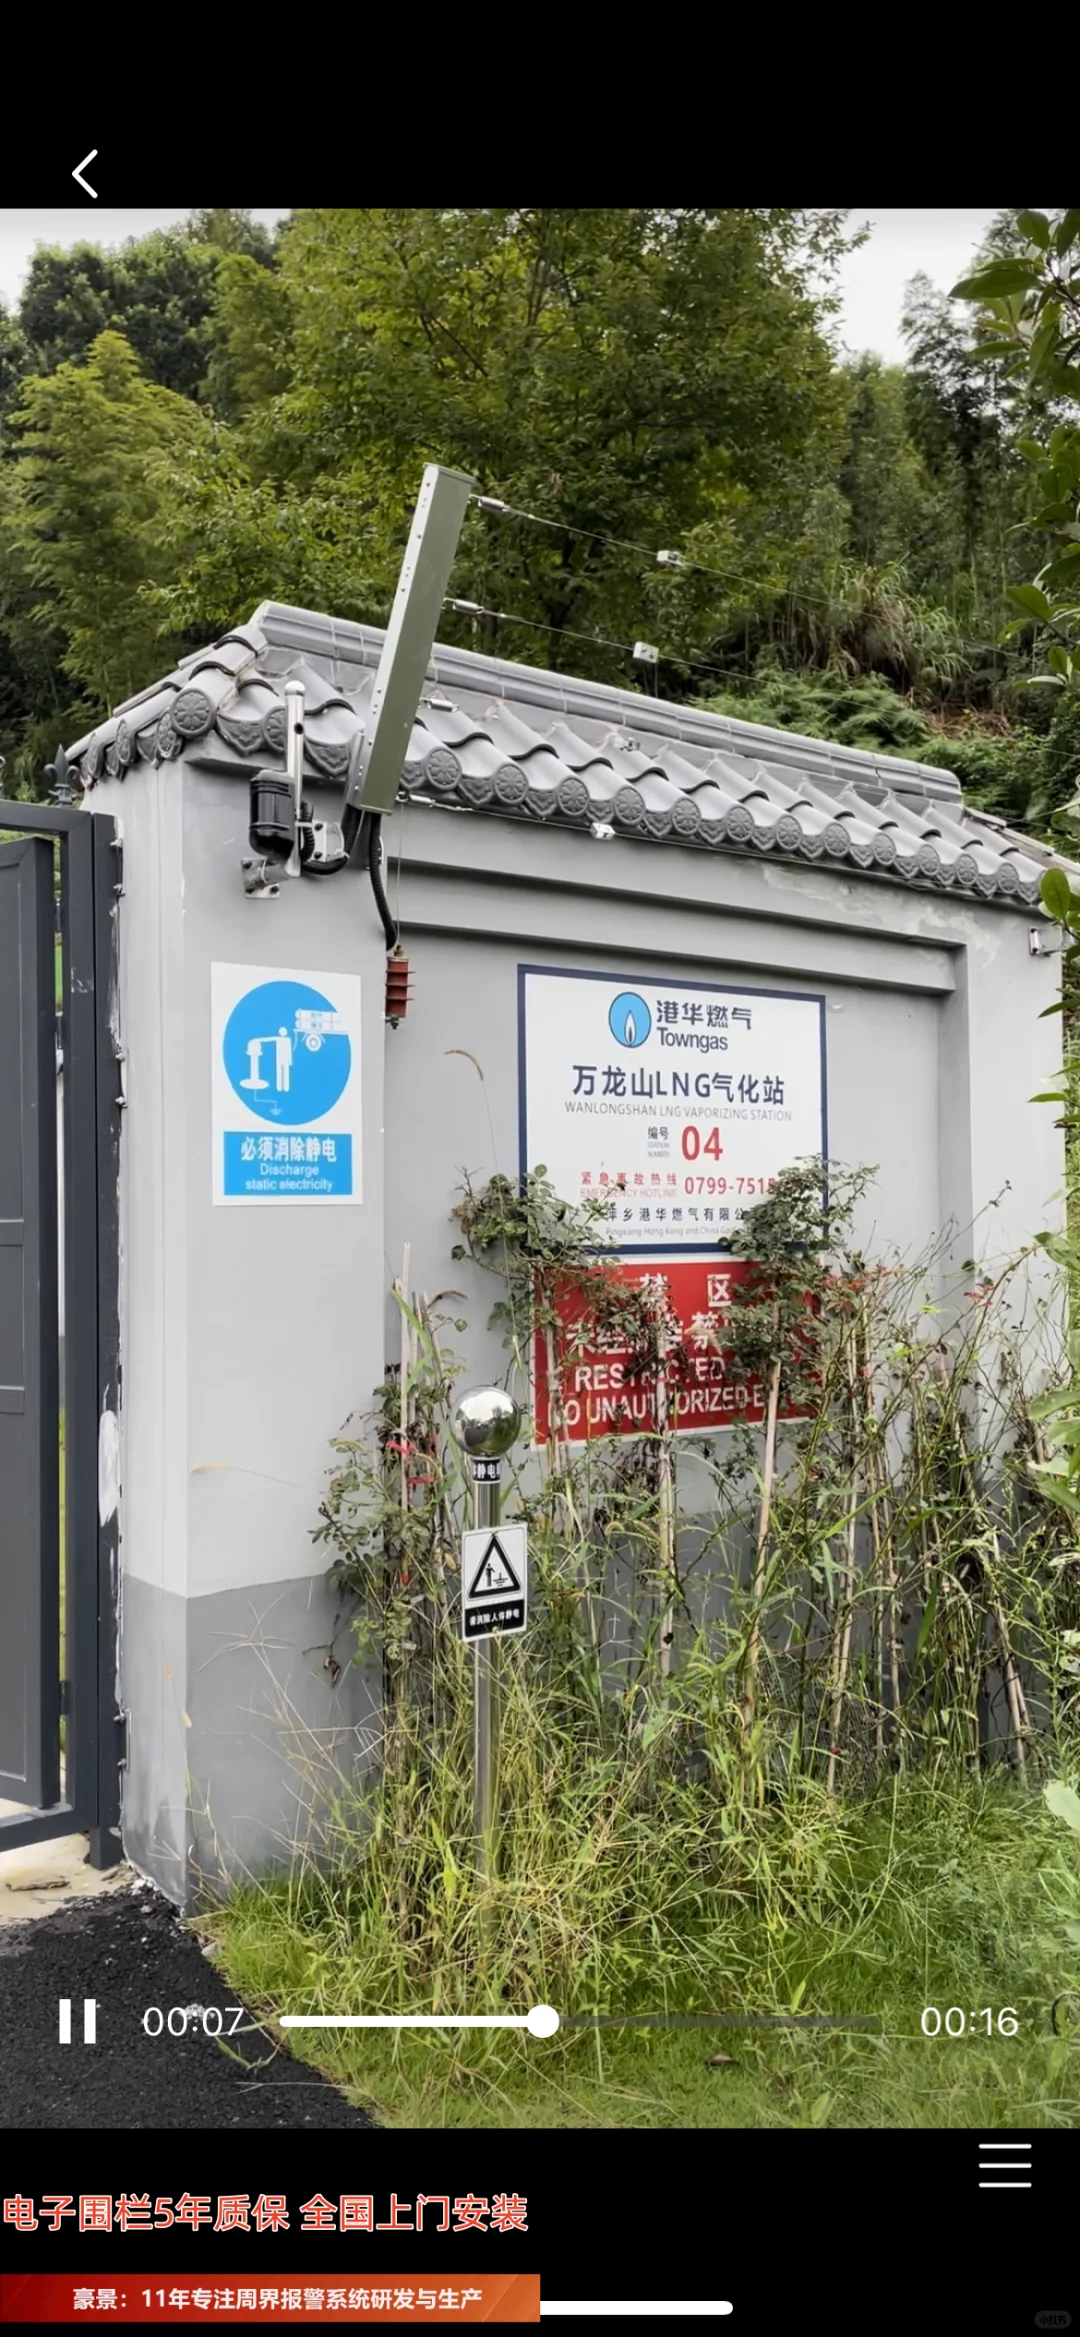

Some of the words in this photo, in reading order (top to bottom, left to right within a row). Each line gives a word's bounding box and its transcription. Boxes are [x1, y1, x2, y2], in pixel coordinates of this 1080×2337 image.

[656, 1000, 752, 1030] 港华燃气
[656, 1027, 728, 1053] Towngas
[572, 1065, 785, 1105] 万龙山LNG气化站
[564, 1101, 657, 1117] WANLONGSHAN
[659, 1105, 682, 1118] LNG
[684, 1106, 748, 1120] VAPORIZING
[750, 1109, 792, 1122] STATION
[241, 1136, 336, 1161] 必须消除静电
[647, 1126, 669, 1140] 编号
[681, 1125, 723, 1161] 04
[260, 1163, 319, 1177] Discharge
[580, 1171, 677, 1187] 紧急事故热线
[245, 1178, 277, 1190] static
[279, 1179, 333, 1193] electricity
[580, 1187, 638, 1199] EMERGENCY
[639, 1188, 677, 1198] HOTLINE
[605, 1226, 642, 1238] Pingxiang
[644, 1227, 662, 1237] Hong
[665, 1226, 684, 1237] Kong
[685, 1226, 699, 1235] and
[700, 1225, 720, 1235] China
